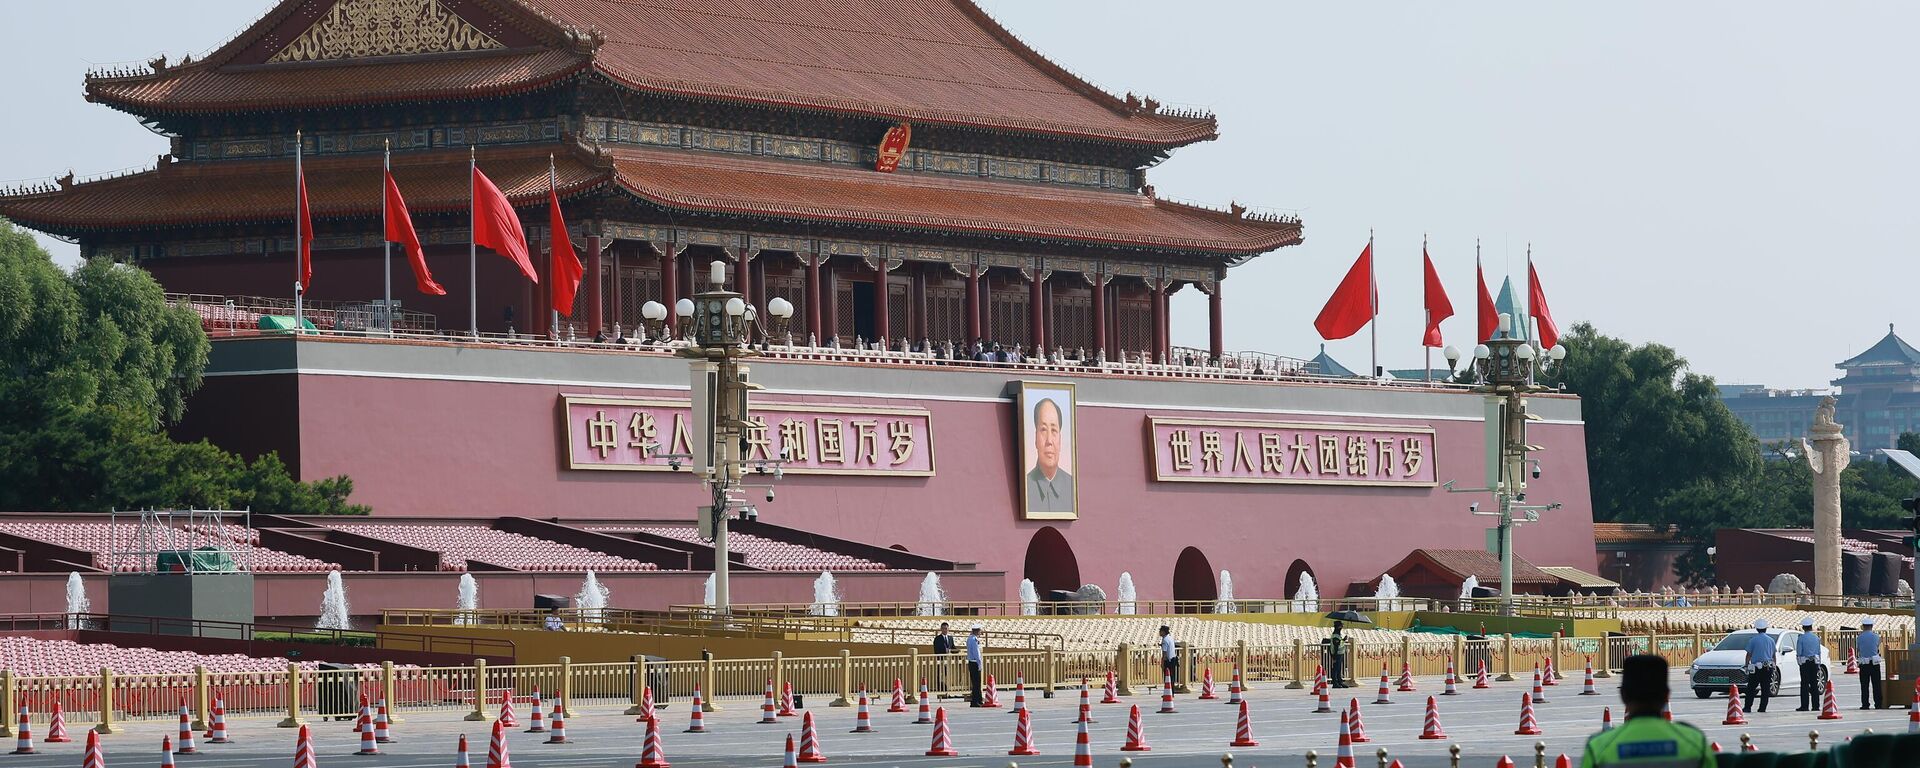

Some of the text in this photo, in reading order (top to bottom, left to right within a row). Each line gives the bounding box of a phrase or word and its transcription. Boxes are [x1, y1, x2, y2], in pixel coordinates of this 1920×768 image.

[588, 411, 915, 465] 中华人共和国万岁
[1170, 430, 1424, 477] 世界人民大团结万岁
